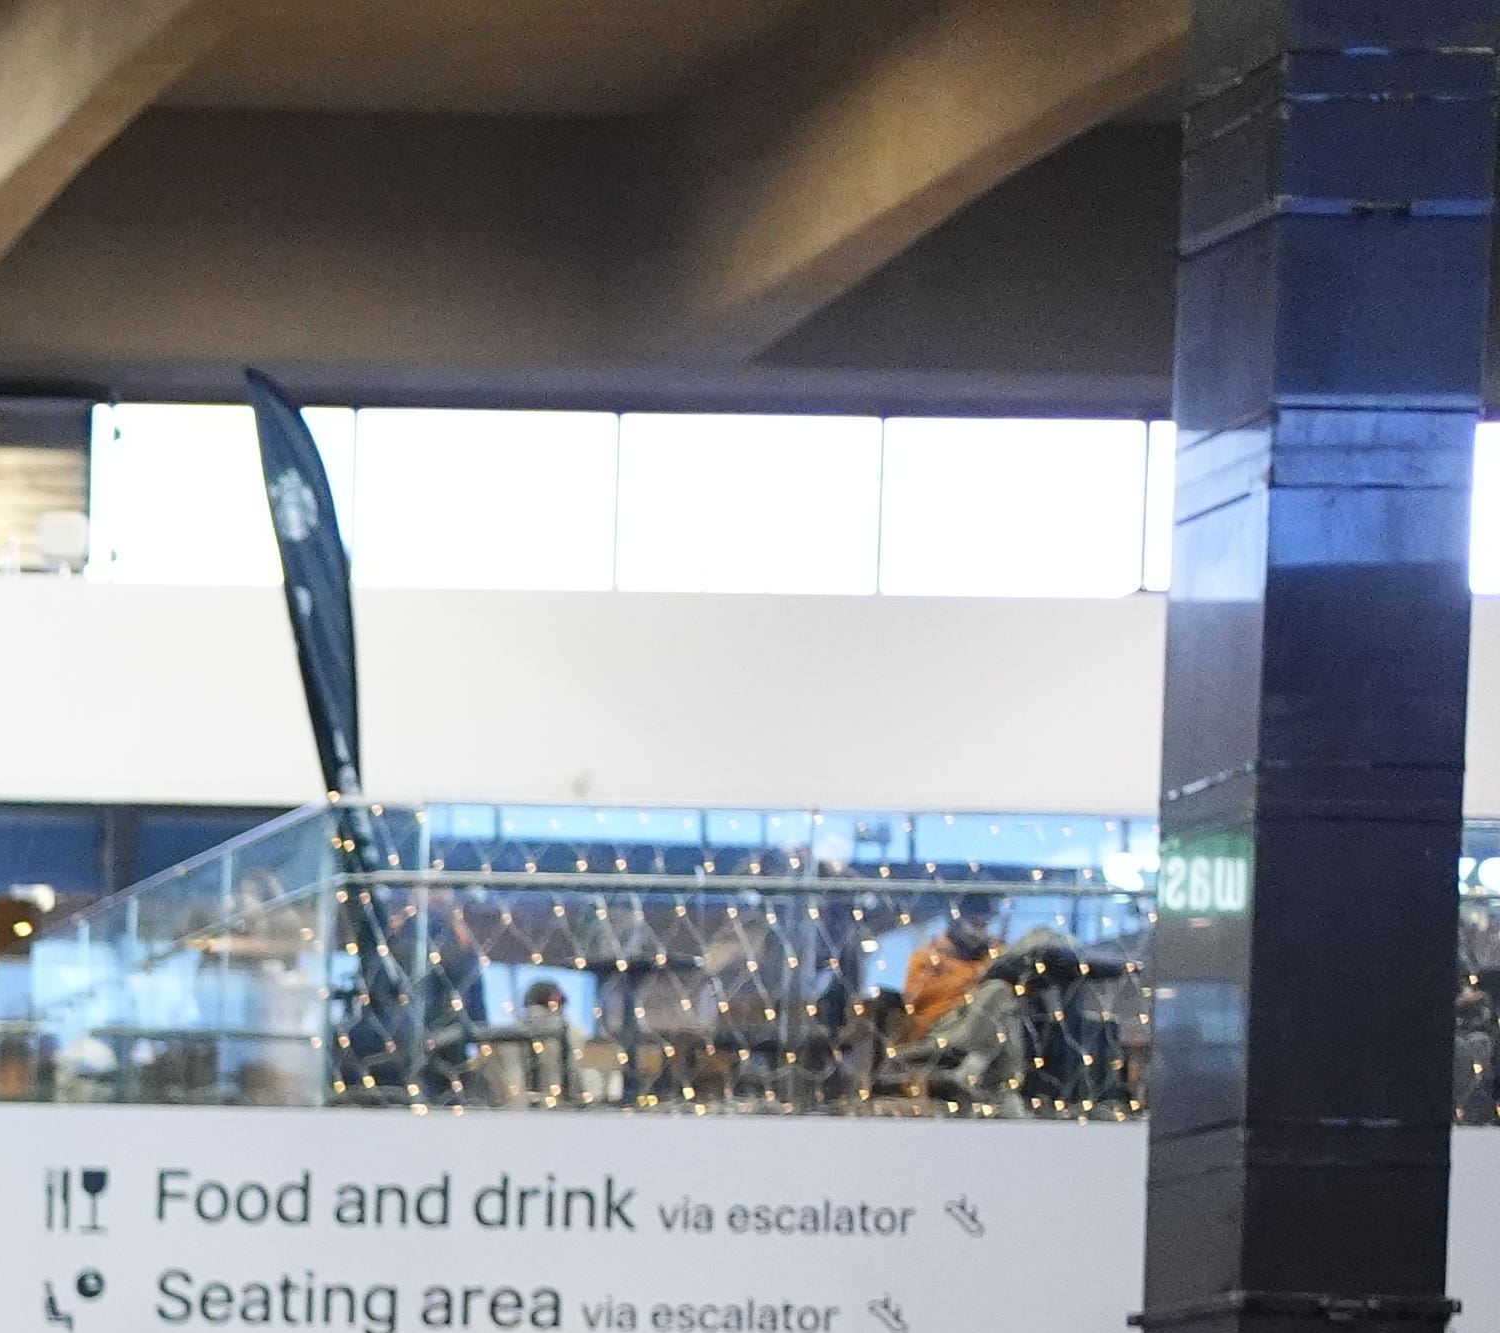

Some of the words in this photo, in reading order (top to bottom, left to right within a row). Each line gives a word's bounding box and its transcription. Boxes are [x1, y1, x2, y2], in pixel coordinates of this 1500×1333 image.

[157, 1170, 313, 1227] Food
[334, 1174, 452, 1229] and
[473, 1174, 636, 1233] drink
[659, 1203, 716, 1235] via
[727, 1200, 917, 1238] escalator
[421, 1287, 563, 1331] area
[582, 1302, 639, 1333] via
